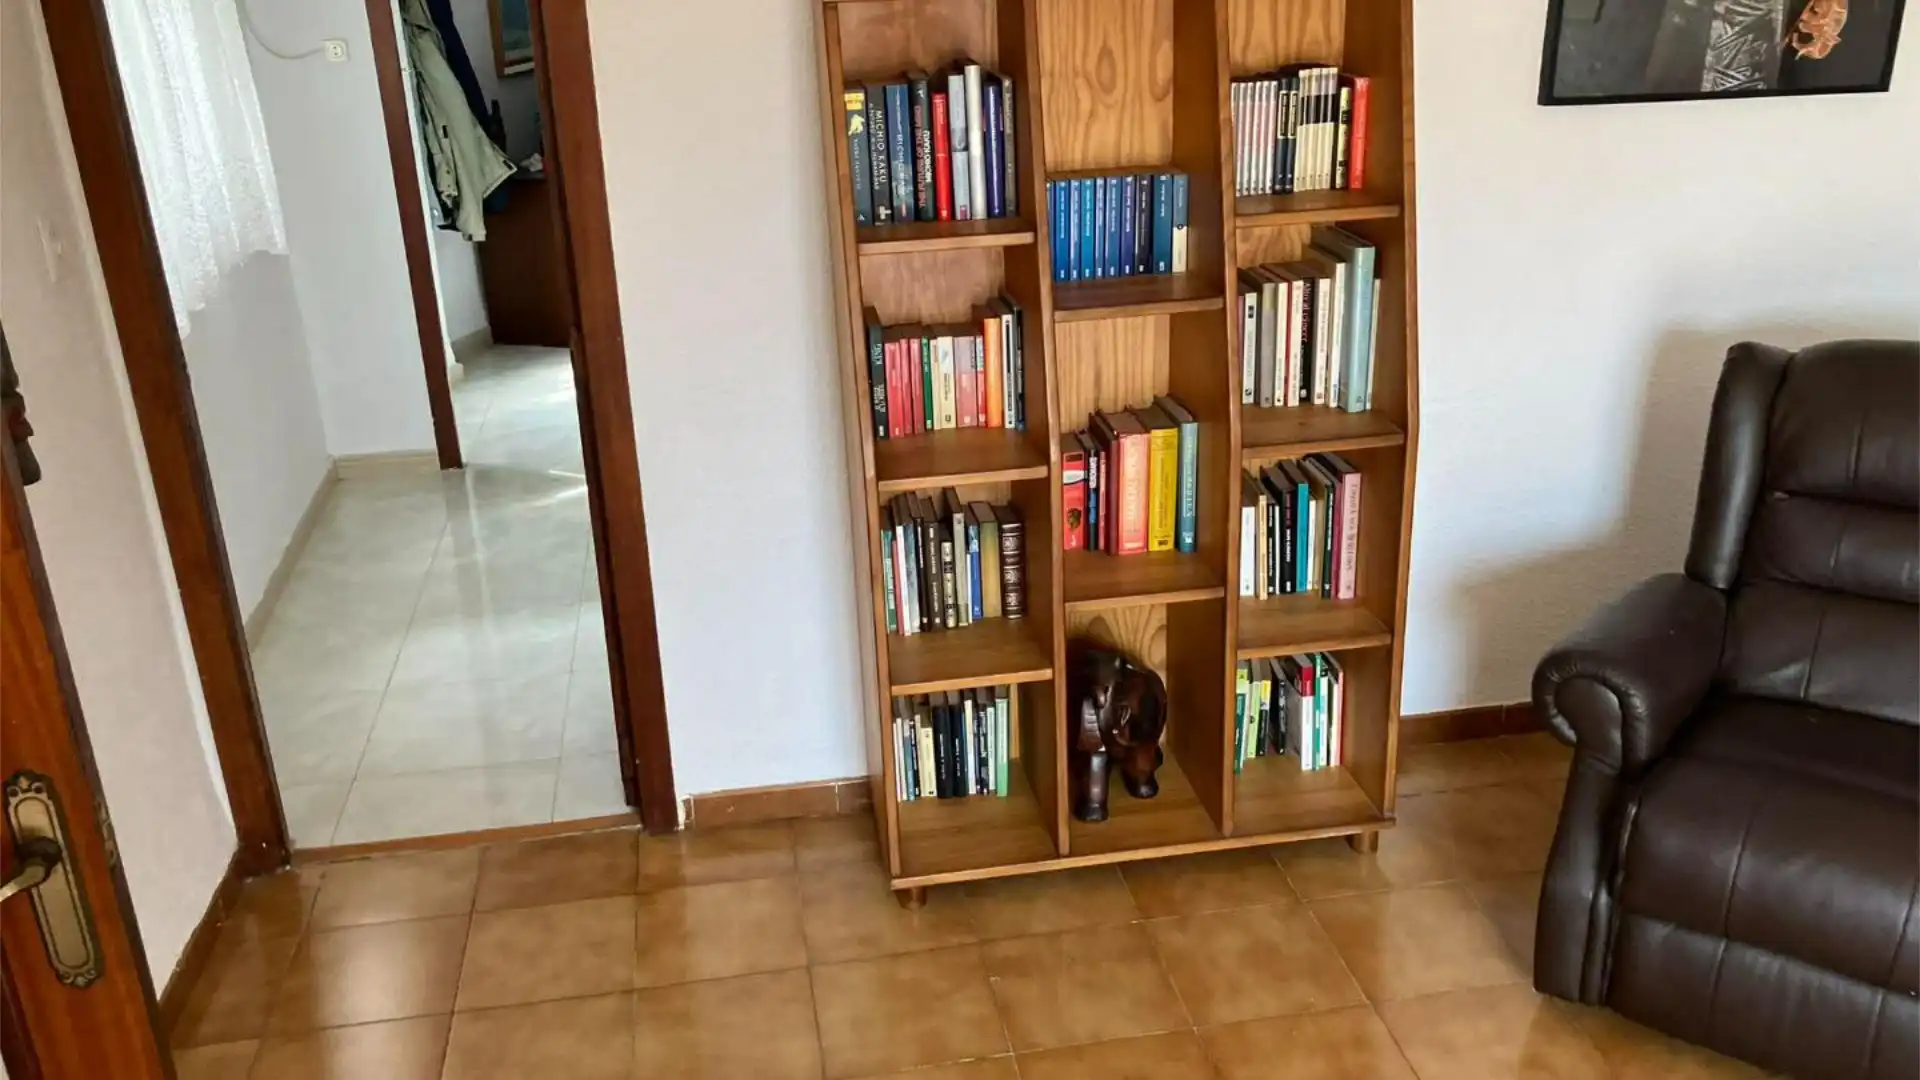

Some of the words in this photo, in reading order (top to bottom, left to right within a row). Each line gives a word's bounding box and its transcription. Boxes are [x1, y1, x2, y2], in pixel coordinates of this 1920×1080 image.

[875, 110, 885, 151] MICHIO
[923, 130, 931, 153] KAKU
[878, 154, 888, 183] KAKU
[924, 155, 932, 183] MICHIO
